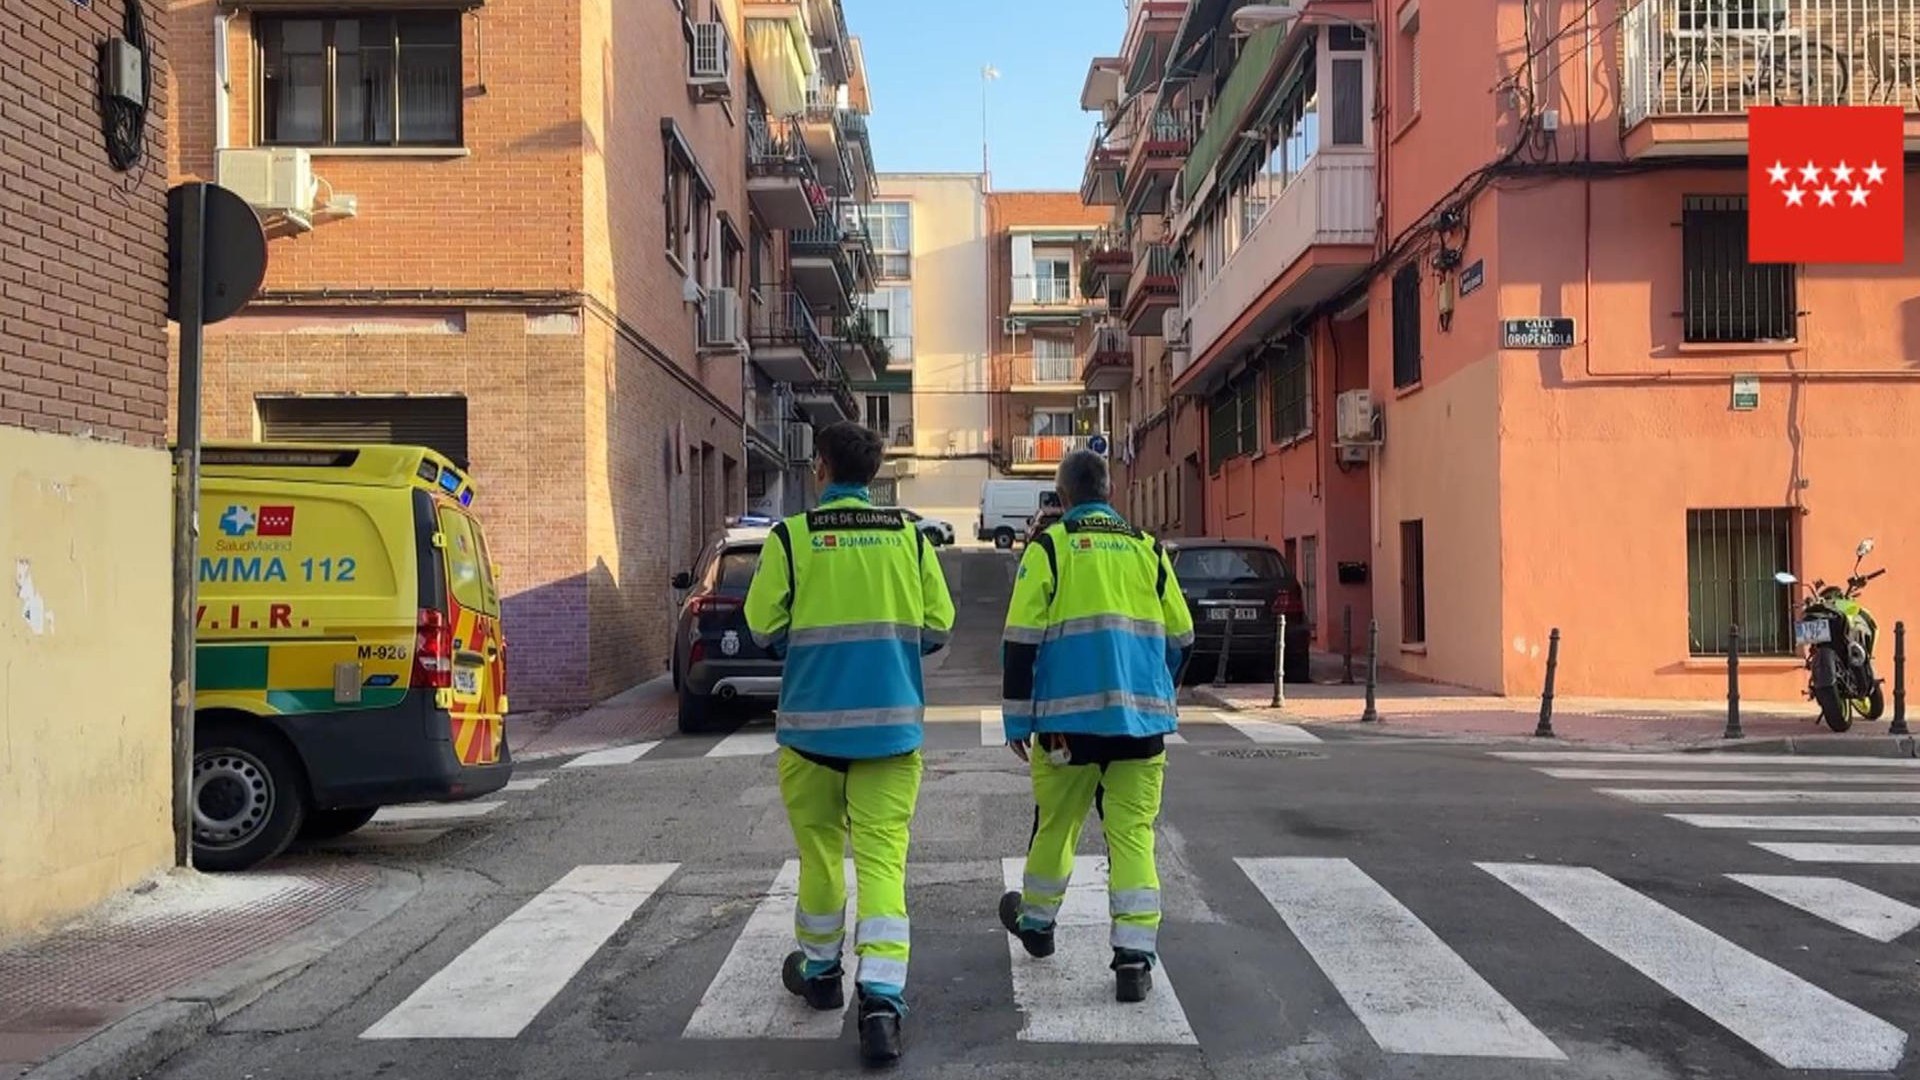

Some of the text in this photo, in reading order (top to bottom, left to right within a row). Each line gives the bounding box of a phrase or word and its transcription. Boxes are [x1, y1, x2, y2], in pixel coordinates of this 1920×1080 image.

[1525, 319, 1554, 328] CALLE
[812, 512, 901, 525] JEFE DE GUARDIA
[839, 535, 902, 548] SUMMA 112
[198, 557, 356, 582] MMA 112
[357, 645, 407, 660] M-926
